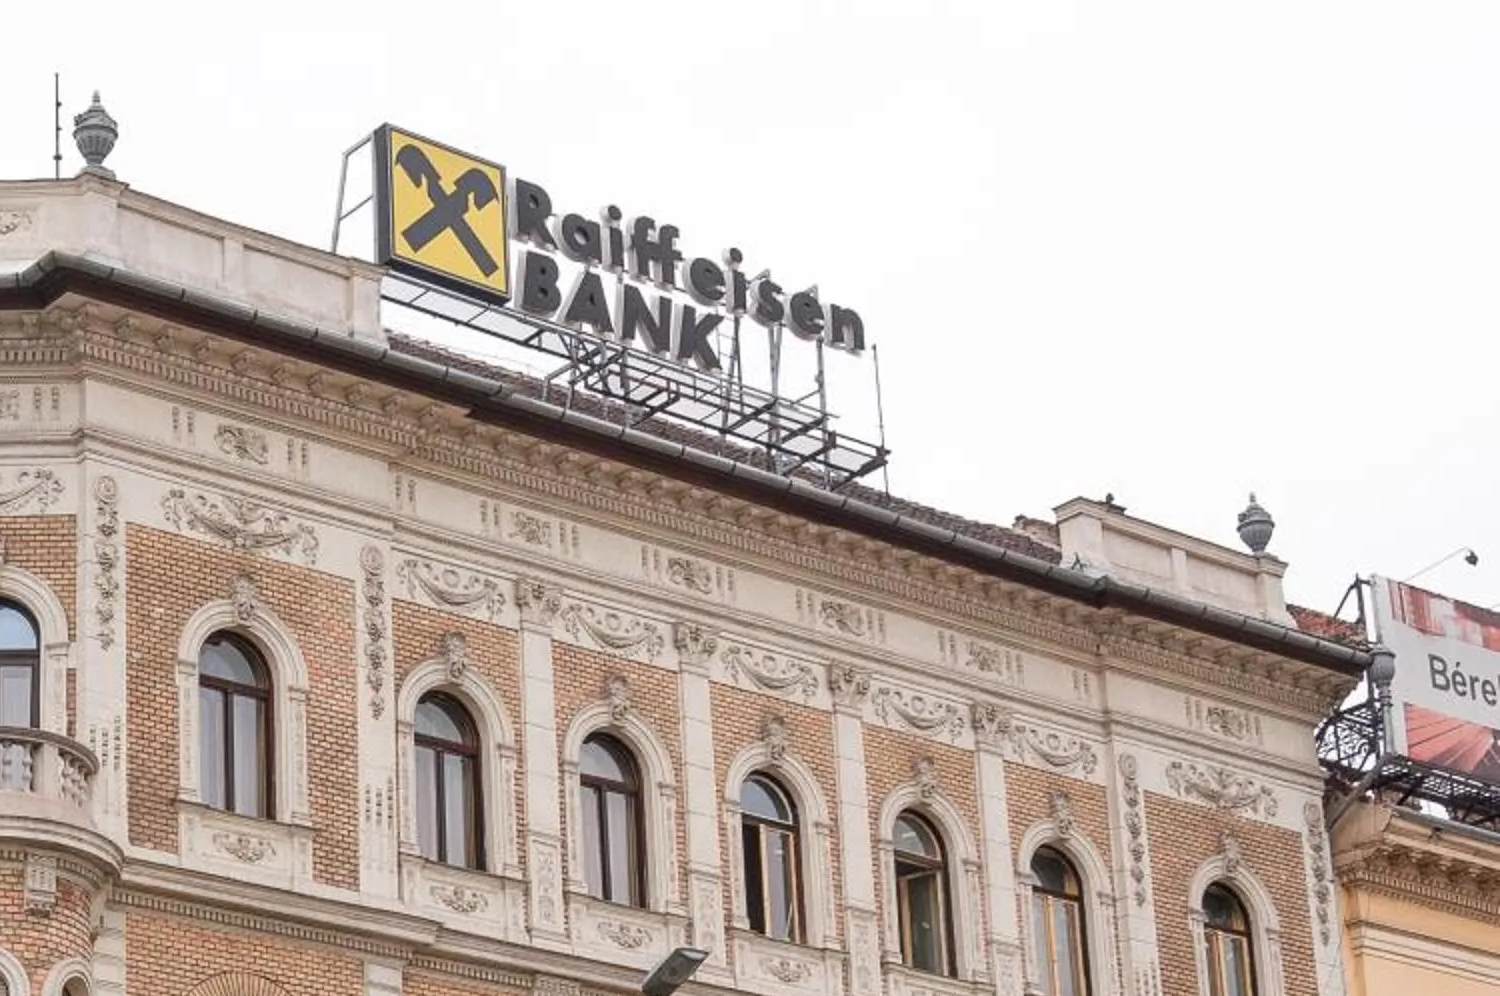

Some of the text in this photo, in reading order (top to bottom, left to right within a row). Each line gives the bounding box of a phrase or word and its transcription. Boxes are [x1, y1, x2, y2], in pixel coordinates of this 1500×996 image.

[513, 177, 866, 352] Raiffeisen
[516, 250, 723, 372] BANK
[1428, 653, 1500, 706] Bére
